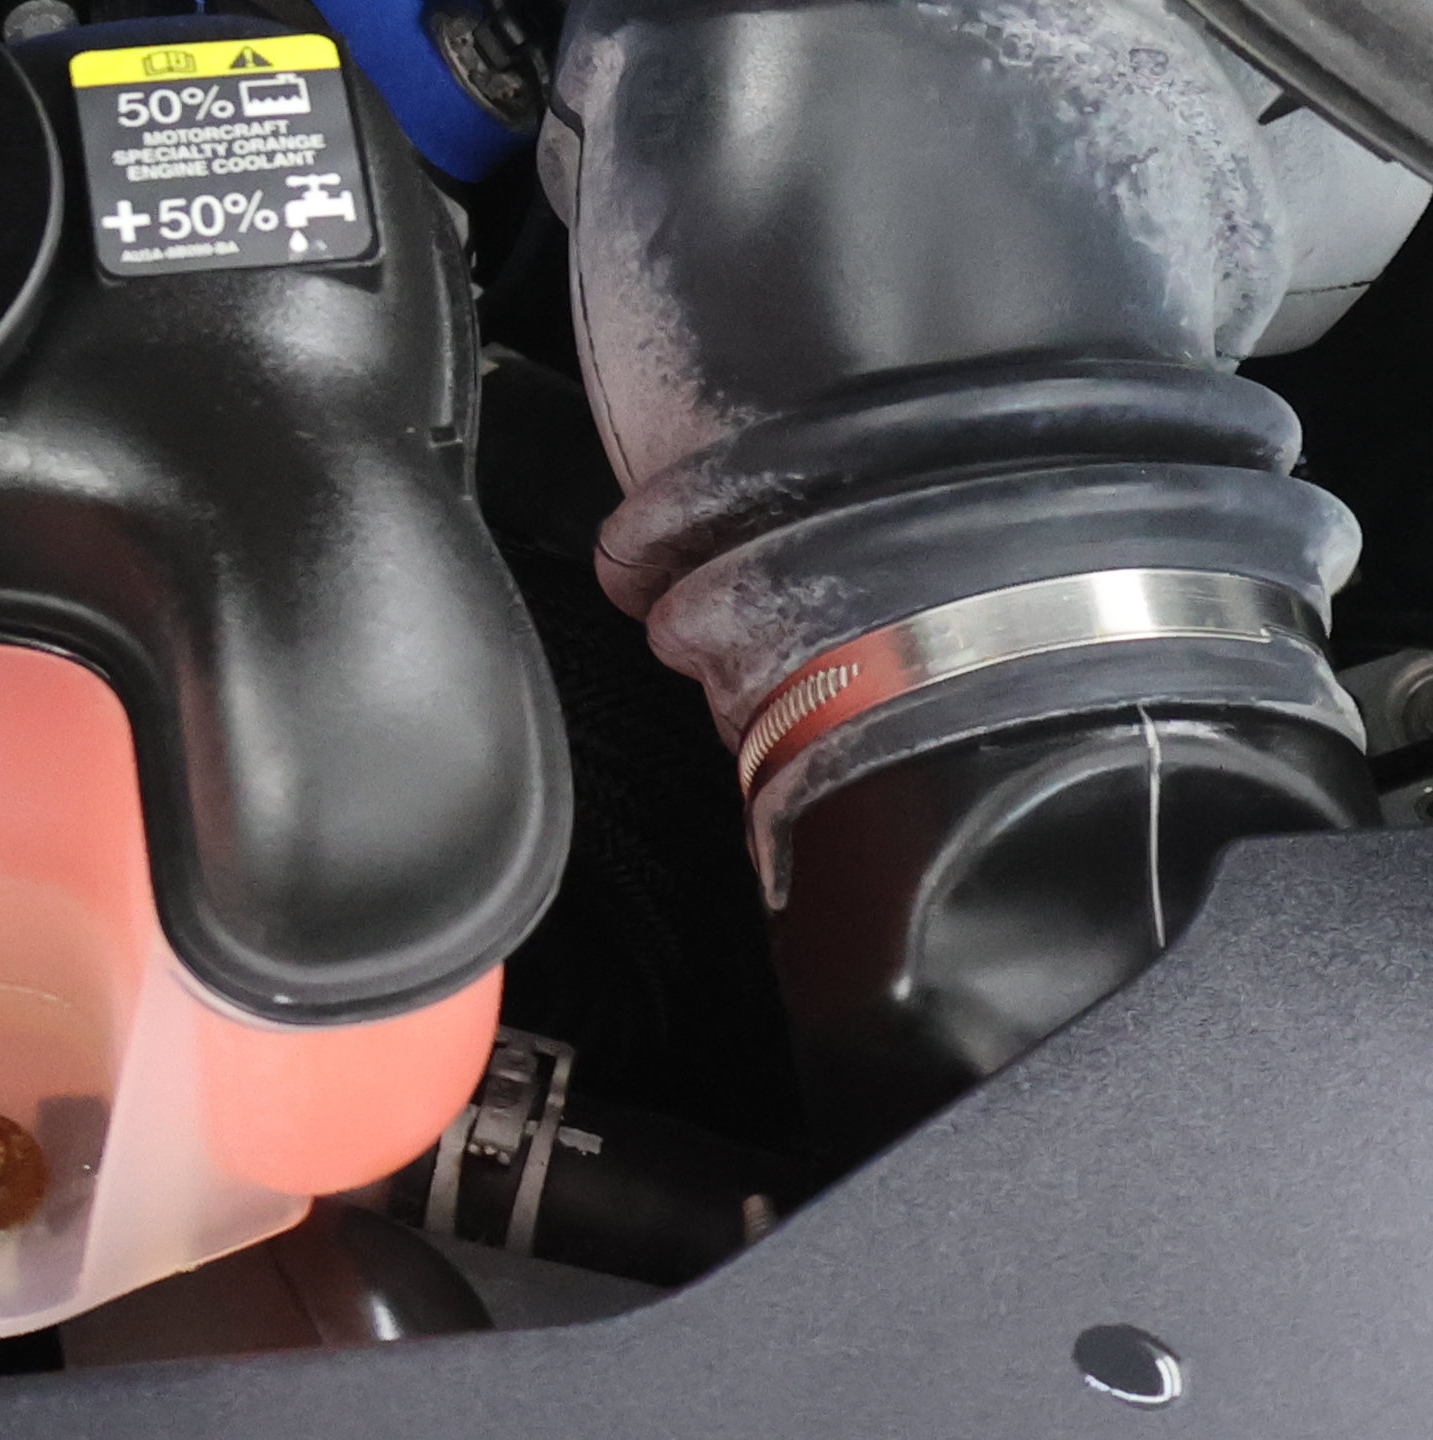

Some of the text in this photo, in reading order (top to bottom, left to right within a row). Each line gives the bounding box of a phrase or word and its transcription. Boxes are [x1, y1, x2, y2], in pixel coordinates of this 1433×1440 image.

[117, 85, 235, 128] 50%
[142, 119, 290, 147] MOTORCRAFT
[111, 133, 326, 166] SPECIALTY ORANGE
[126, 150, 317, 182] ENGINE COOLANT
